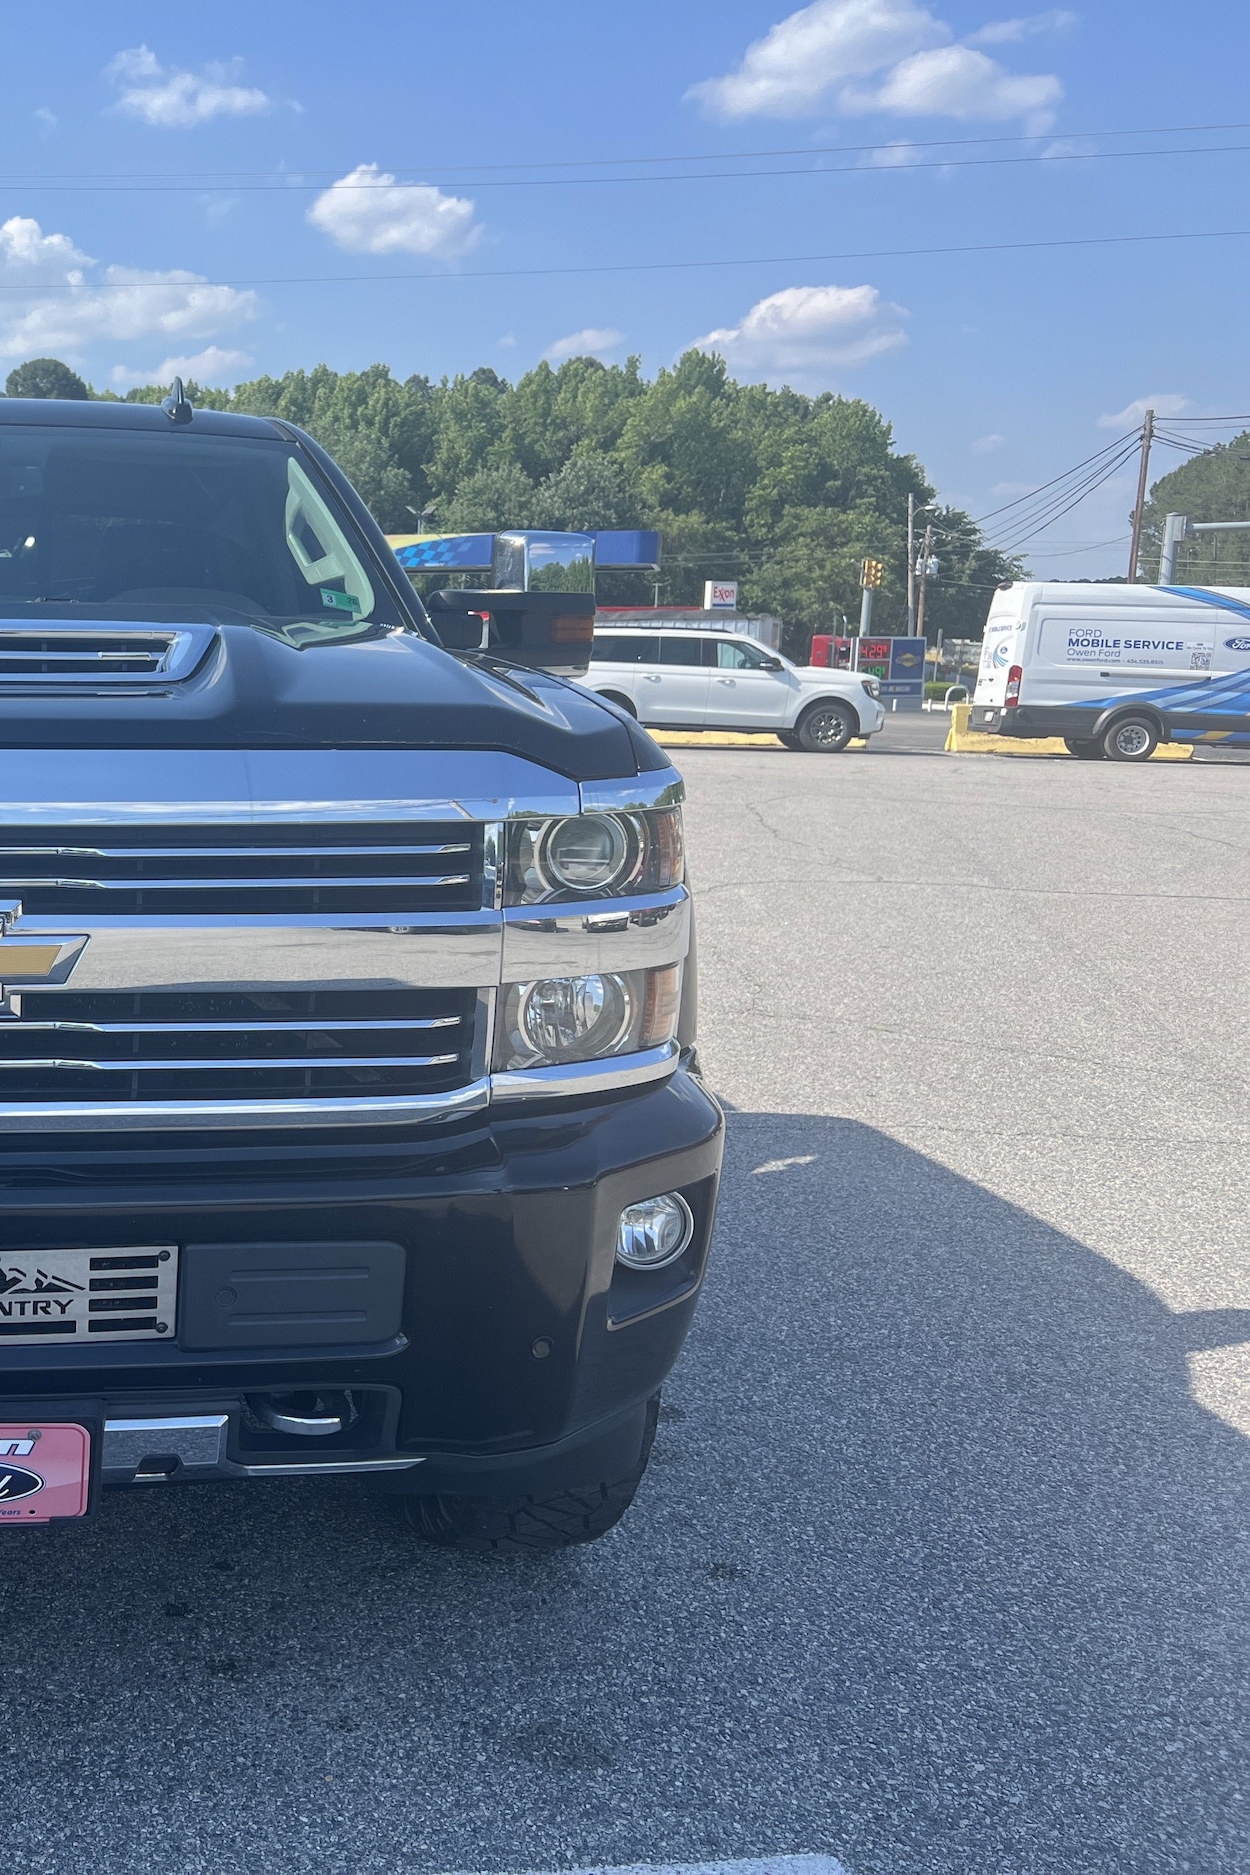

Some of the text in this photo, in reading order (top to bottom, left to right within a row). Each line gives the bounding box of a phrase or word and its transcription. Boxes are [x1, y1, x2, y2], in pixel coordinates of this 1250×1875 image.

[327, 595, 334, 603] 3
[1068, 628, 1102, 638] FORD
[1068, 638, 1184, 651] MOBILE SERVICE
[1232, 638, 1250, 650] For
[1067, 648, 1121, 658] Owen Ford
